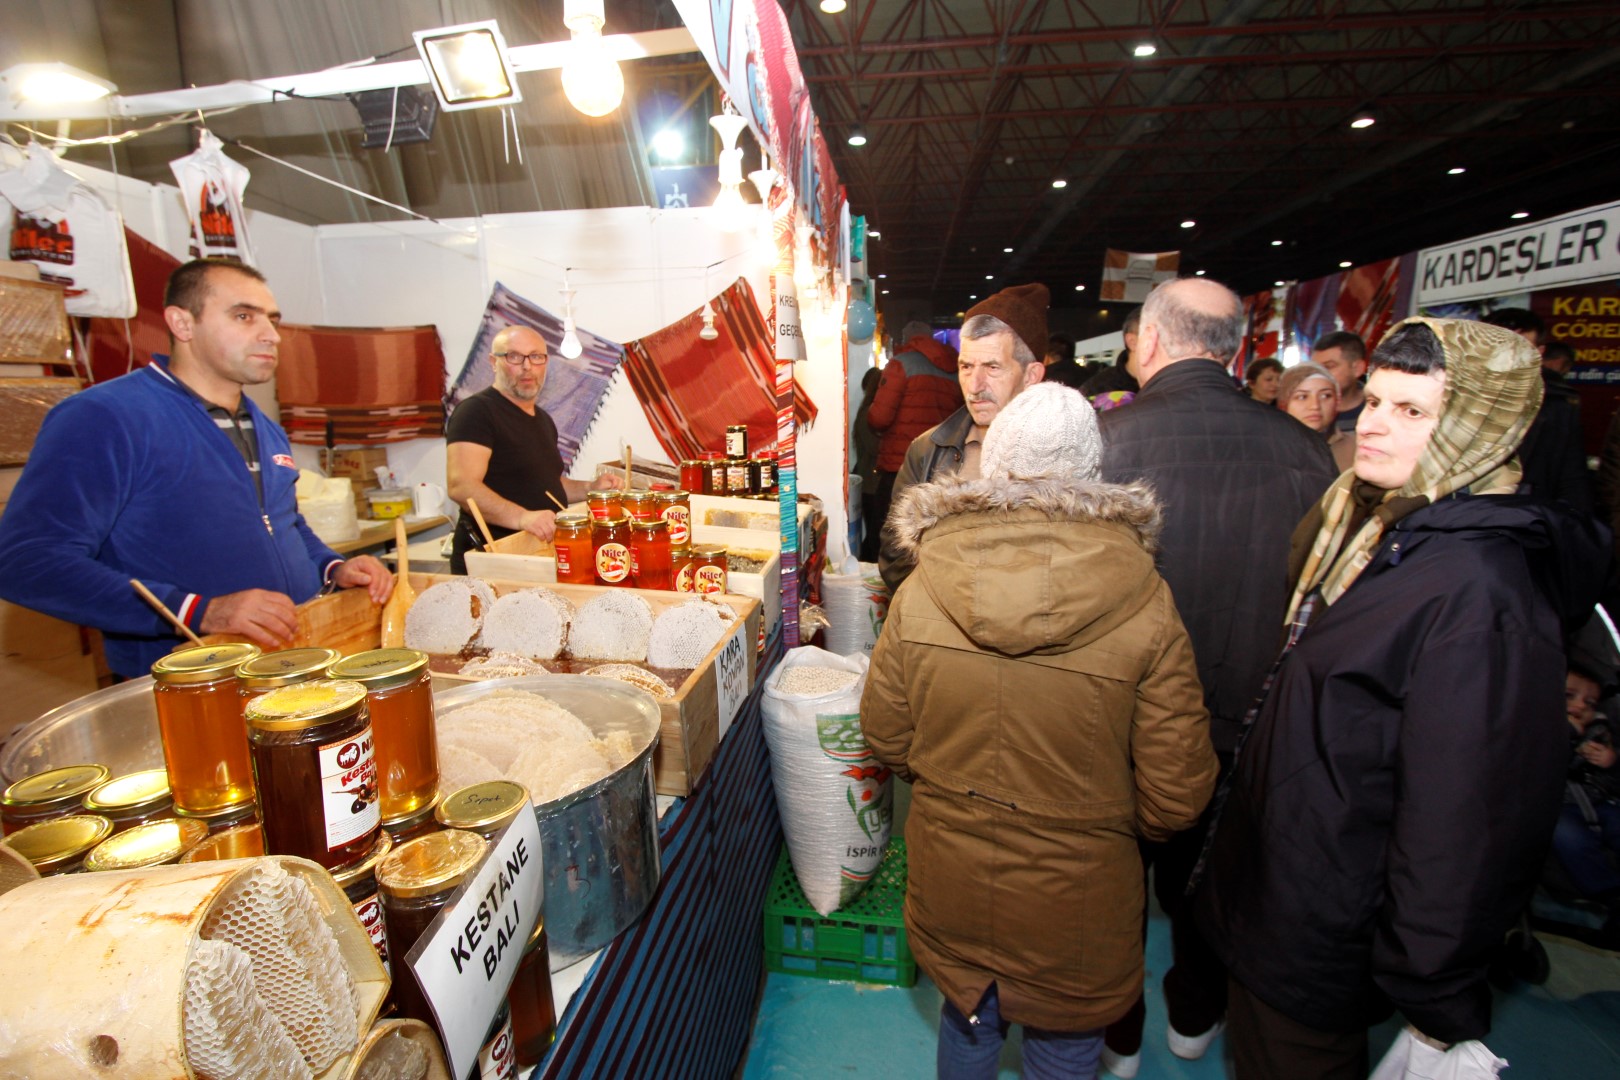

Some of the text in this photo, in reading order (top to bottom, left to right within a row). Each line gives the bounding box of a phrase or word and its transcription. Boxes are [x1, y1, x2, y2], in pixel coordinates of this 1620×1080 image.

[1422, 219, 1607, 291] KARDEŞLER
[1552, 296, 1620, 316] KAR
[1551, 318, 1620, 340] ÇÖRE
[601, 549, 627, 558] Niler
[699, 571, 722, 580] Niler
[719, 635, 741, 679] KARA
[846, 844, 878, 858] İSPİR
[450, 837, 529, 975] KESTANE
[483, 899, 520, 982] BALI
